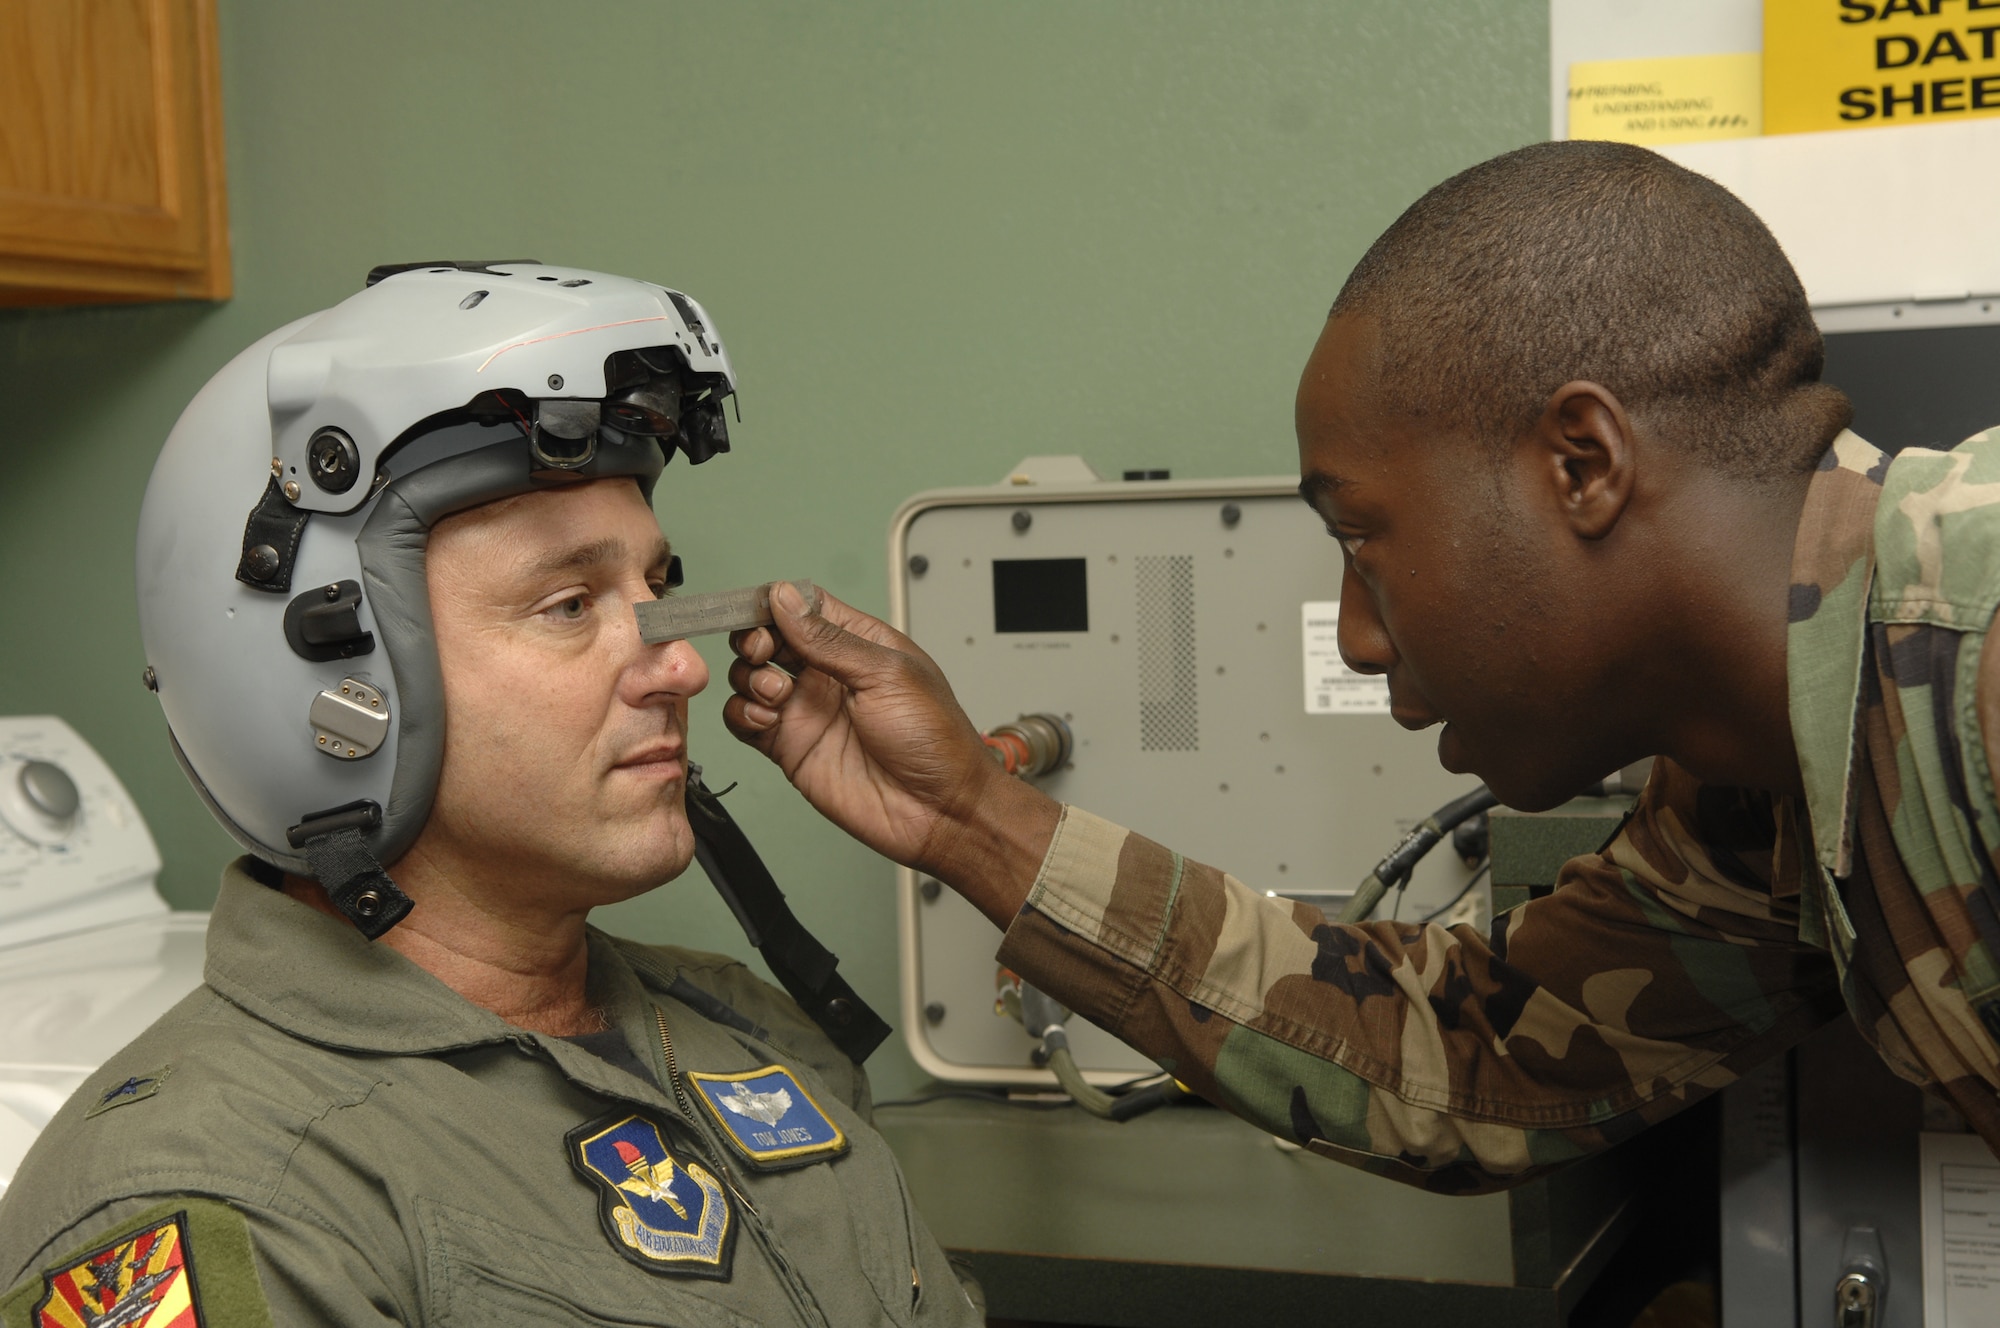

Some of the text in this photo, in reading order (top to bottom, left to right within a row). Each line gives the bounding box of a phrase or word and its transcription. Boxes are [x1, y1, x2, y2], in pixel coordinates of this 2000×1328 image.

[1876, 24, 2000, 69] DAT
[1592, 97, 1712, 115] UNDERSTANDING
[1839, 72, 2000, 121] SHEE
[1626, 116, 1656, 132] AND
[751, 1126, 813, 1147] TOM JONES
